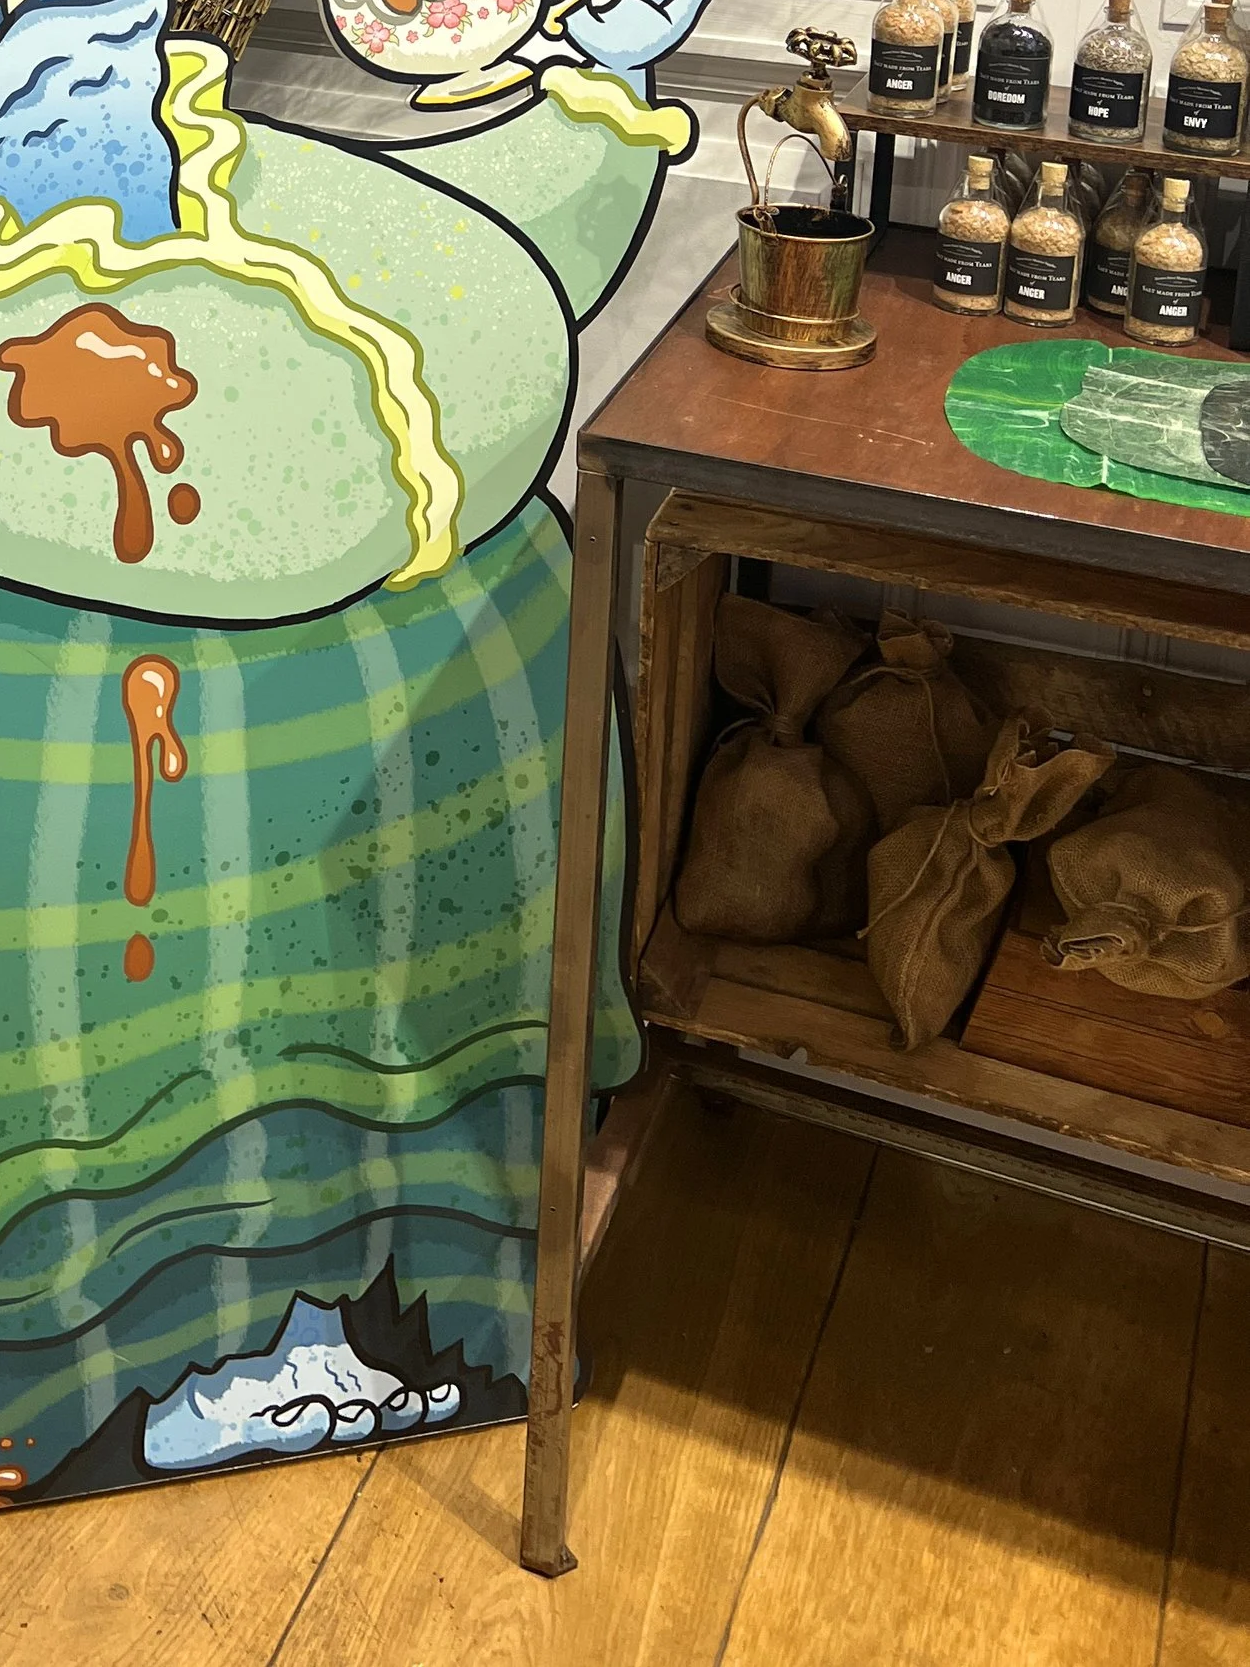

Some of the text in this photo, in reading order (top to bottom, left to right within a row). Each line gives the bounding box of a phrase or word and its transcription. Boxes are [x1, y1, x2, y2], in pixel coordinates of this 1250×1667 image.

[886, 78, 913, 90] ANGER
[987, 90, 1026, 104] BOREDOM
[1088, 106, 1110, 118] HOPE
[1183, 115, 1208, 128] ENVY
[945, 271, 972, 286] ANGER
[1018, 285, 1046, 300] ANGER
[1111, 285, 1129, 297] ANG
[1159, 305, 1188, 317] ANGER
